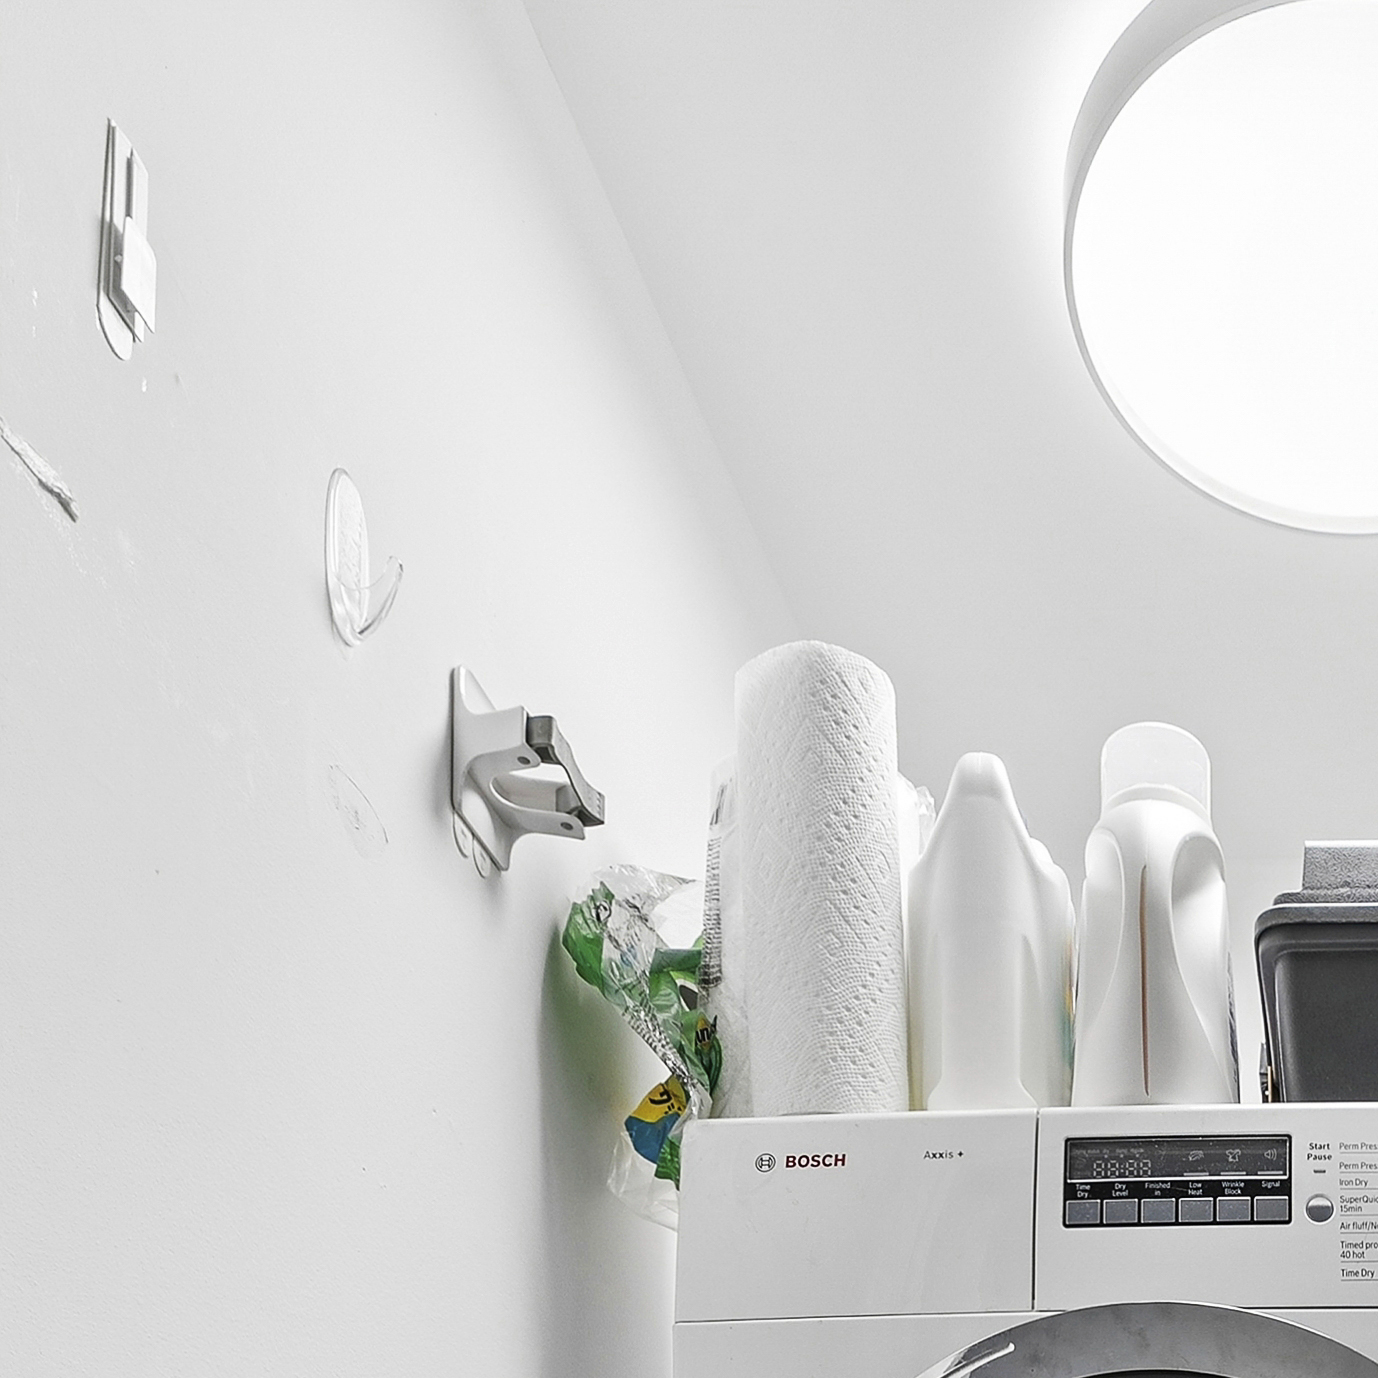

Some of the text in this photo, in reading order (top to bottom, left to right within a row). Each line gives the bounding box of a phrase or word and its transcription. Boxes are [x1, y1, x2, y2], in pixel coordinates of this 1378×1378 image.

[1309, 1142, 1330, 1150] Start
[1339, 1142, 1359, 1150] Perm
[785, 1153, 847, 1169] BOSCH
[923, 1149, 954, 1160] Axxis
[1307, 1153, 1332, 1161] Pause
[1339, 1162, 1359, 1170] Perm
[1114, 1182, 1127, 1191] Dry
[1145, 1181, 1171, 1189] Finished
[1261, 1180, 1281, 1189] Signal
[1339, 1178, 1368, 1187] Iron Dry
[1076, 1183, 1091, 1191] Time
[1224, 1187, 1242, 1195] Block
[1077, 1190, 1089, 1199] Dry
[1112, 1189, 1129, 1197] Level
[1154, 1188, 1162, 1196] in
[1188, 1188, 1203, 1196] Heat
[1339, 1205, 1363, 1213] 15min
[1340, 1221, 1350, 1230] Air
[1340, 1241, 1364, 1249] Timed
[1340, 1250, 1365, 1259] 40 hot
[1341, 1268, 1375, 1279] Time Dry
